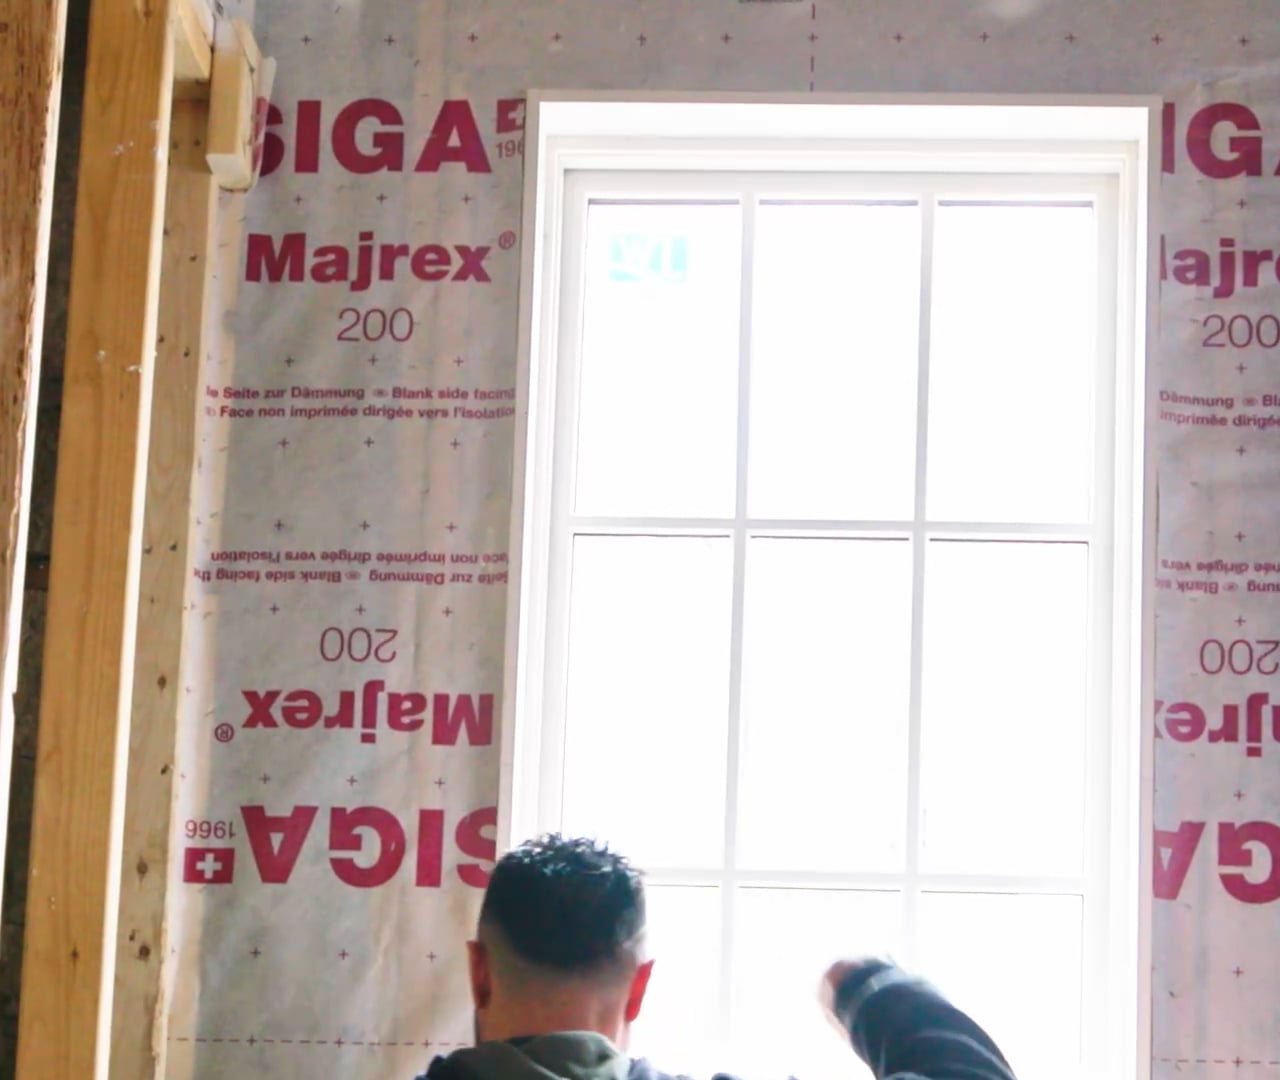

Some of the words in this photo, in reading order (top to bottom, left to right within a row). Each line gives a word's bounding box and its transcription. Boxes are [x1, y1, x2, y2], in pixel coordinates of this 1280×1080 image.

[337, 308, 414, 342] 200
[222, 387, 260, 399] Seite
[263, 389, 286, 399] zur
[290, 386, 365, 401] Dämmung
[391, 387, 433, 400] Blank
[437, 387, 469, 400] side
[219, 406, 255, 418] Face
[258, 408, 286, 418] non
[417, 407, 450, 419] vers
[285, 552, 317, 563] vers
[450, 554, 479, 564] non
[215, 569, 260, 583] facing
[265, 570, 300, 582] side
[303, 570, 342, 583] Blank
[368, 570, 445, 586] Dämmung
[449, 573, 473, 583] zur
[320, 627, 398, 663] 200
[1199, 638, 1280, 676] 200
[185, 819, 236, 840] 1966
